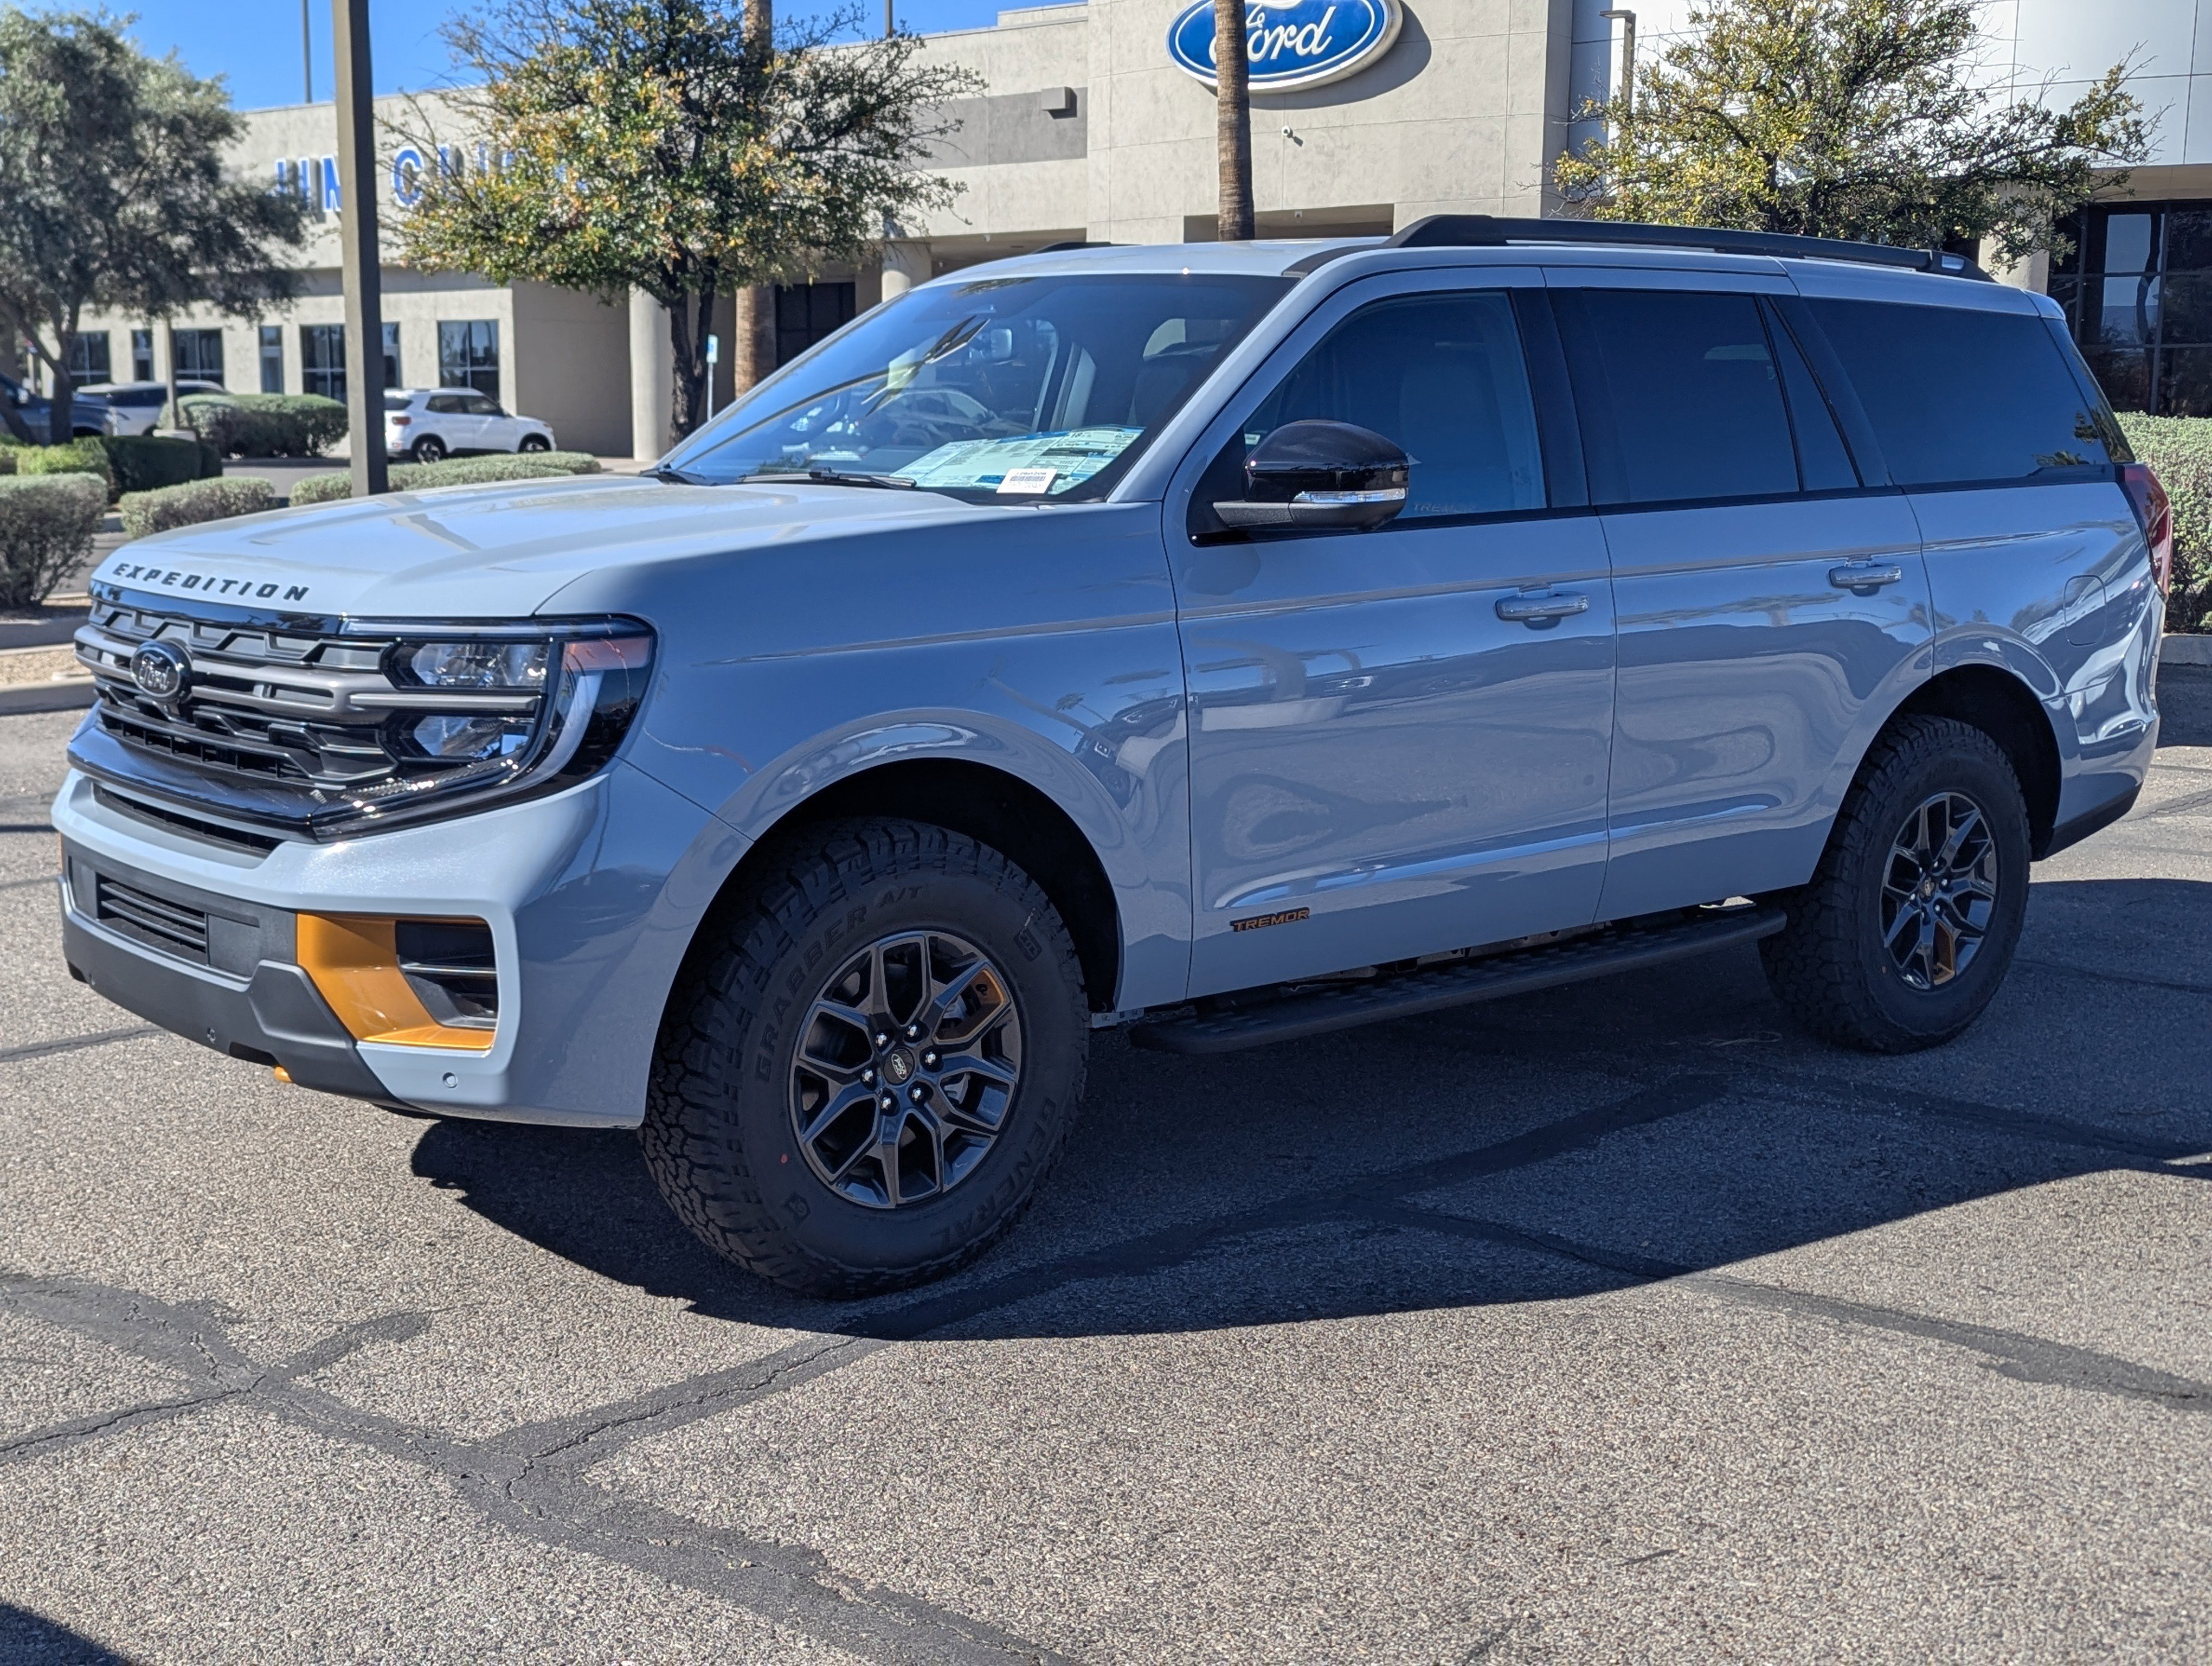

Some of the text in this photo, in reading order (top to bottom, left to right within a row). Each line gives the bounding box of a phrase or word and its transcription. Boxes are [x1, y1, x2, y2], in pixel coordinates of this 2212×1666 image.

[113, 562, 310, 601] EXPEDITION
[1231, 908, 1310, 932] TREMOR
[755, 905, 867, 1082] GRABBER
